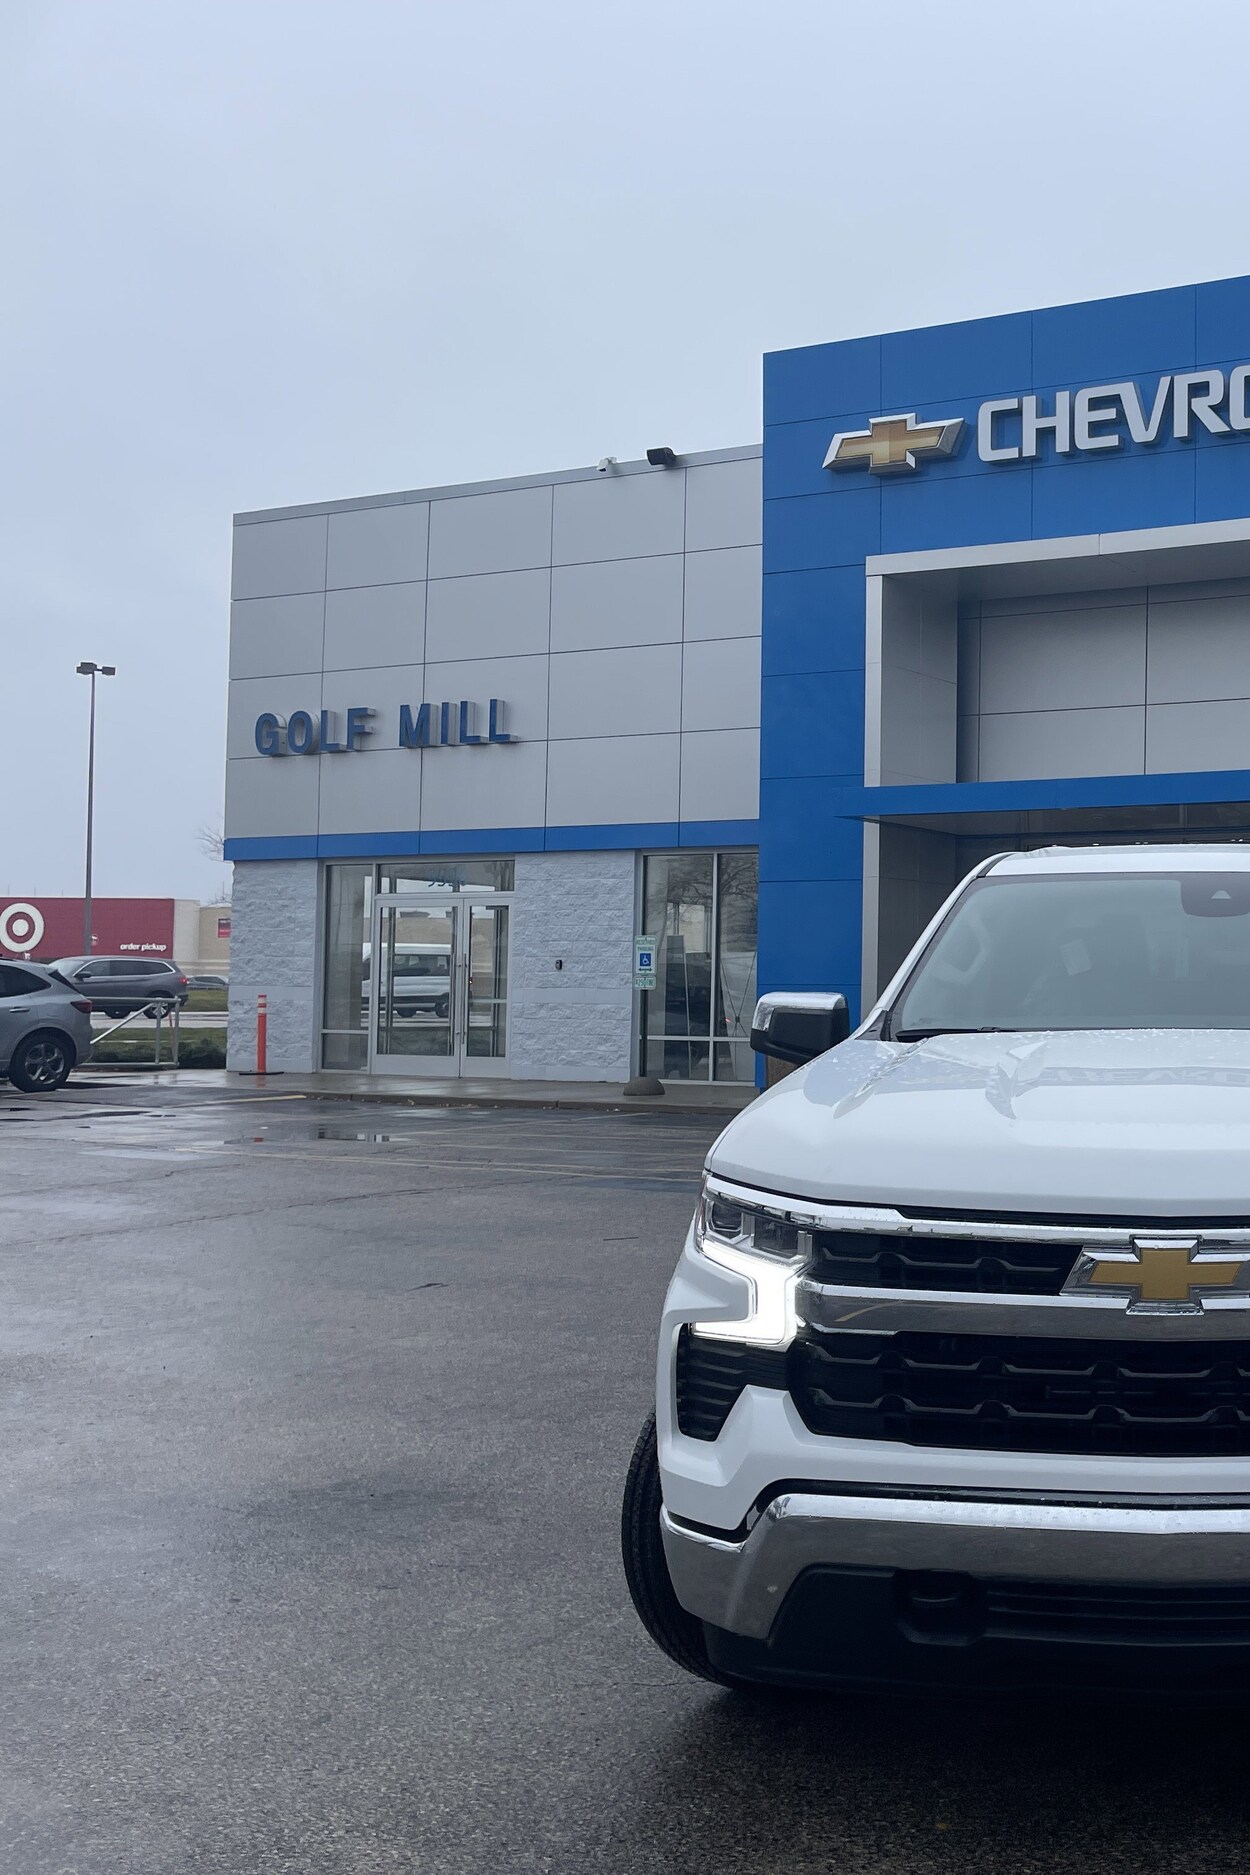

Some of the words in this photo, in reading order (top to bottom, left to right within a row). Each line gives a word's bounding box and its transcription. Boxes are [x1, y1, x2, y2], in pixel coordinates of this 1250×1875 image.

[255, 707, 376, 756] GOLF
[400, 699, 518, 748] MILL
[119, 943, 140, 951] order
[141, 943, 167, 951] pickup
